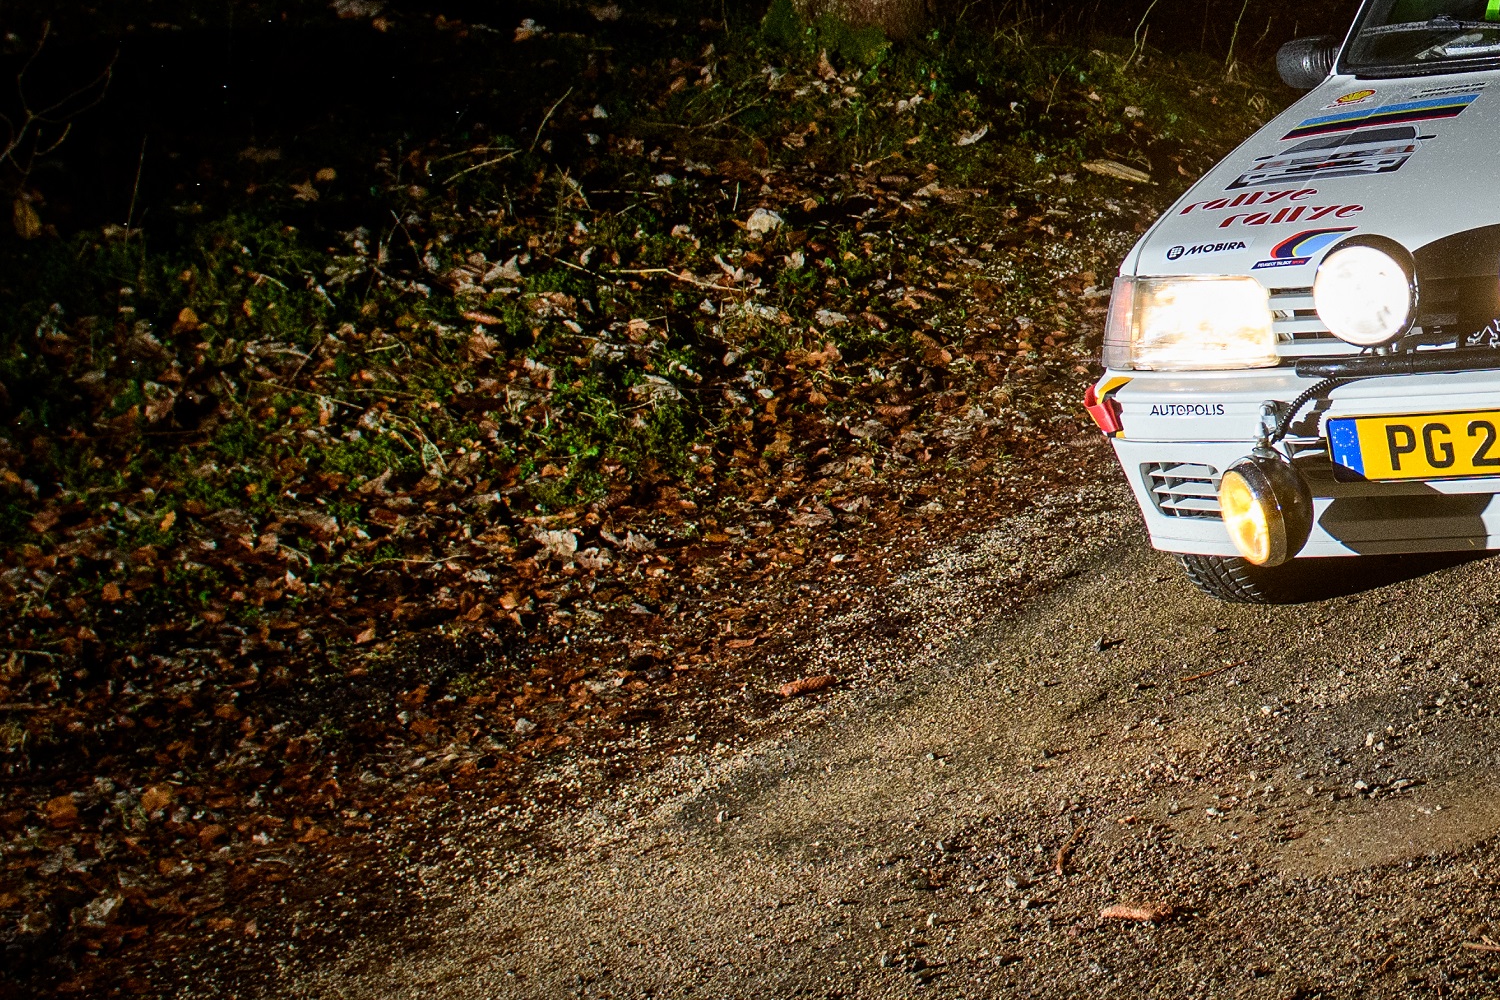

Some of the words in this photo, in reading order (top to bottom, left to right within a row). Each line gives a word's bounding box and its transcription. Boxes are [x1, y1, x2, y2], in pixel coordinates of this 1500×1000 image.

[1179, 189, 1318, 215] rallye
[1218, 204, 1364, 229] rallye
[1184, 241, 1246, 256] MOBIRA
[1150, 404, 1225, 416] AUTOPOLIS
[1385, 421, 1456, 471] PG
